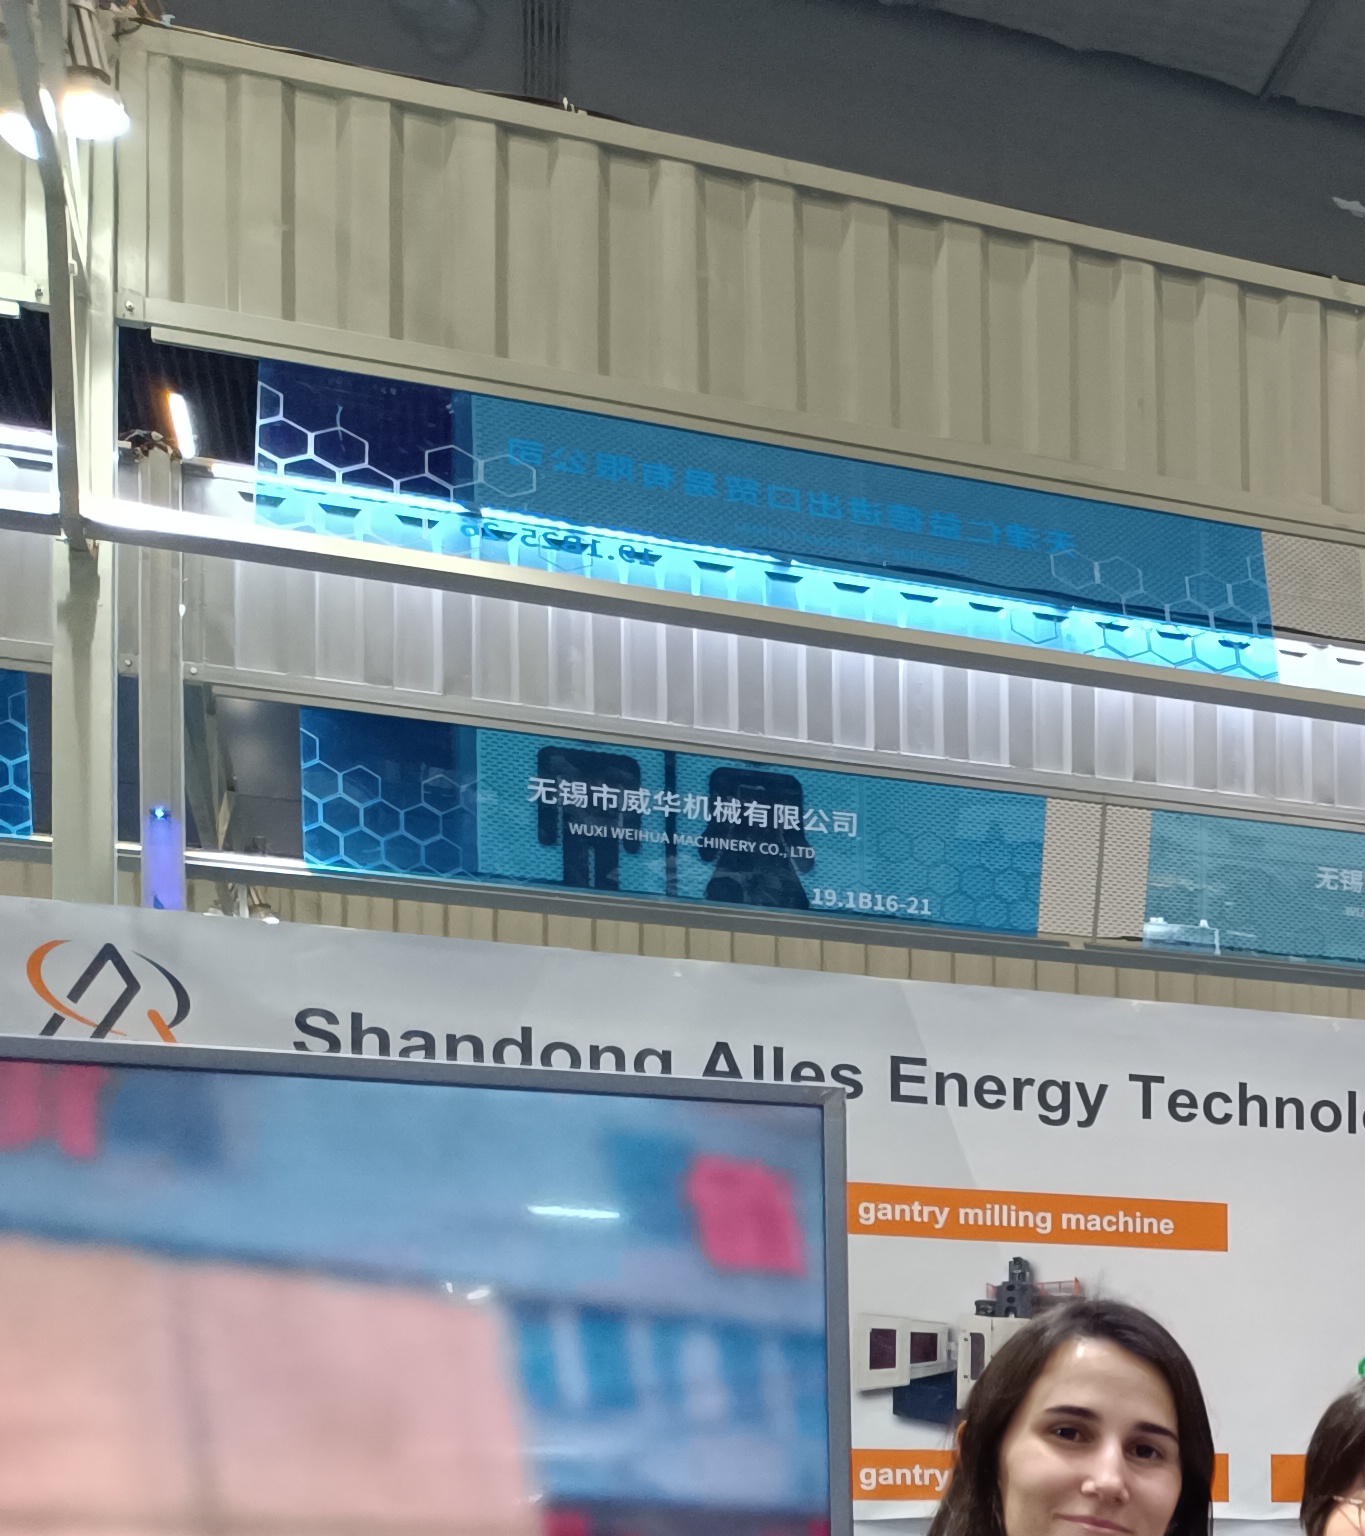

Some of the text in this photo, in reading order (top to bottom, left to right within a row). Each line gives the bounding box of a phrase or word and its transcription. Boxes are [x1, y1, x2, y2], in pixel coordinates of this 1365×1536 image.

[528, 776, 859, 838] 无锡市威华机械有限公司
[569, 822, 607, 839] WUXI
[610, 826, 671, 844] WEIHUA
[673, 833, 757, 854] MACHINERY
[790, 846, 816, 859] LTD
[811, 887, 932, 917] 19.1B16-21
[701, 1040, 864, 1101] Alles
[889, 1055, 1109, 1128] Energy
[857, 1199, 1175, 1237] gantry milling machine
[858, 1461, 949, 1493] gantry
